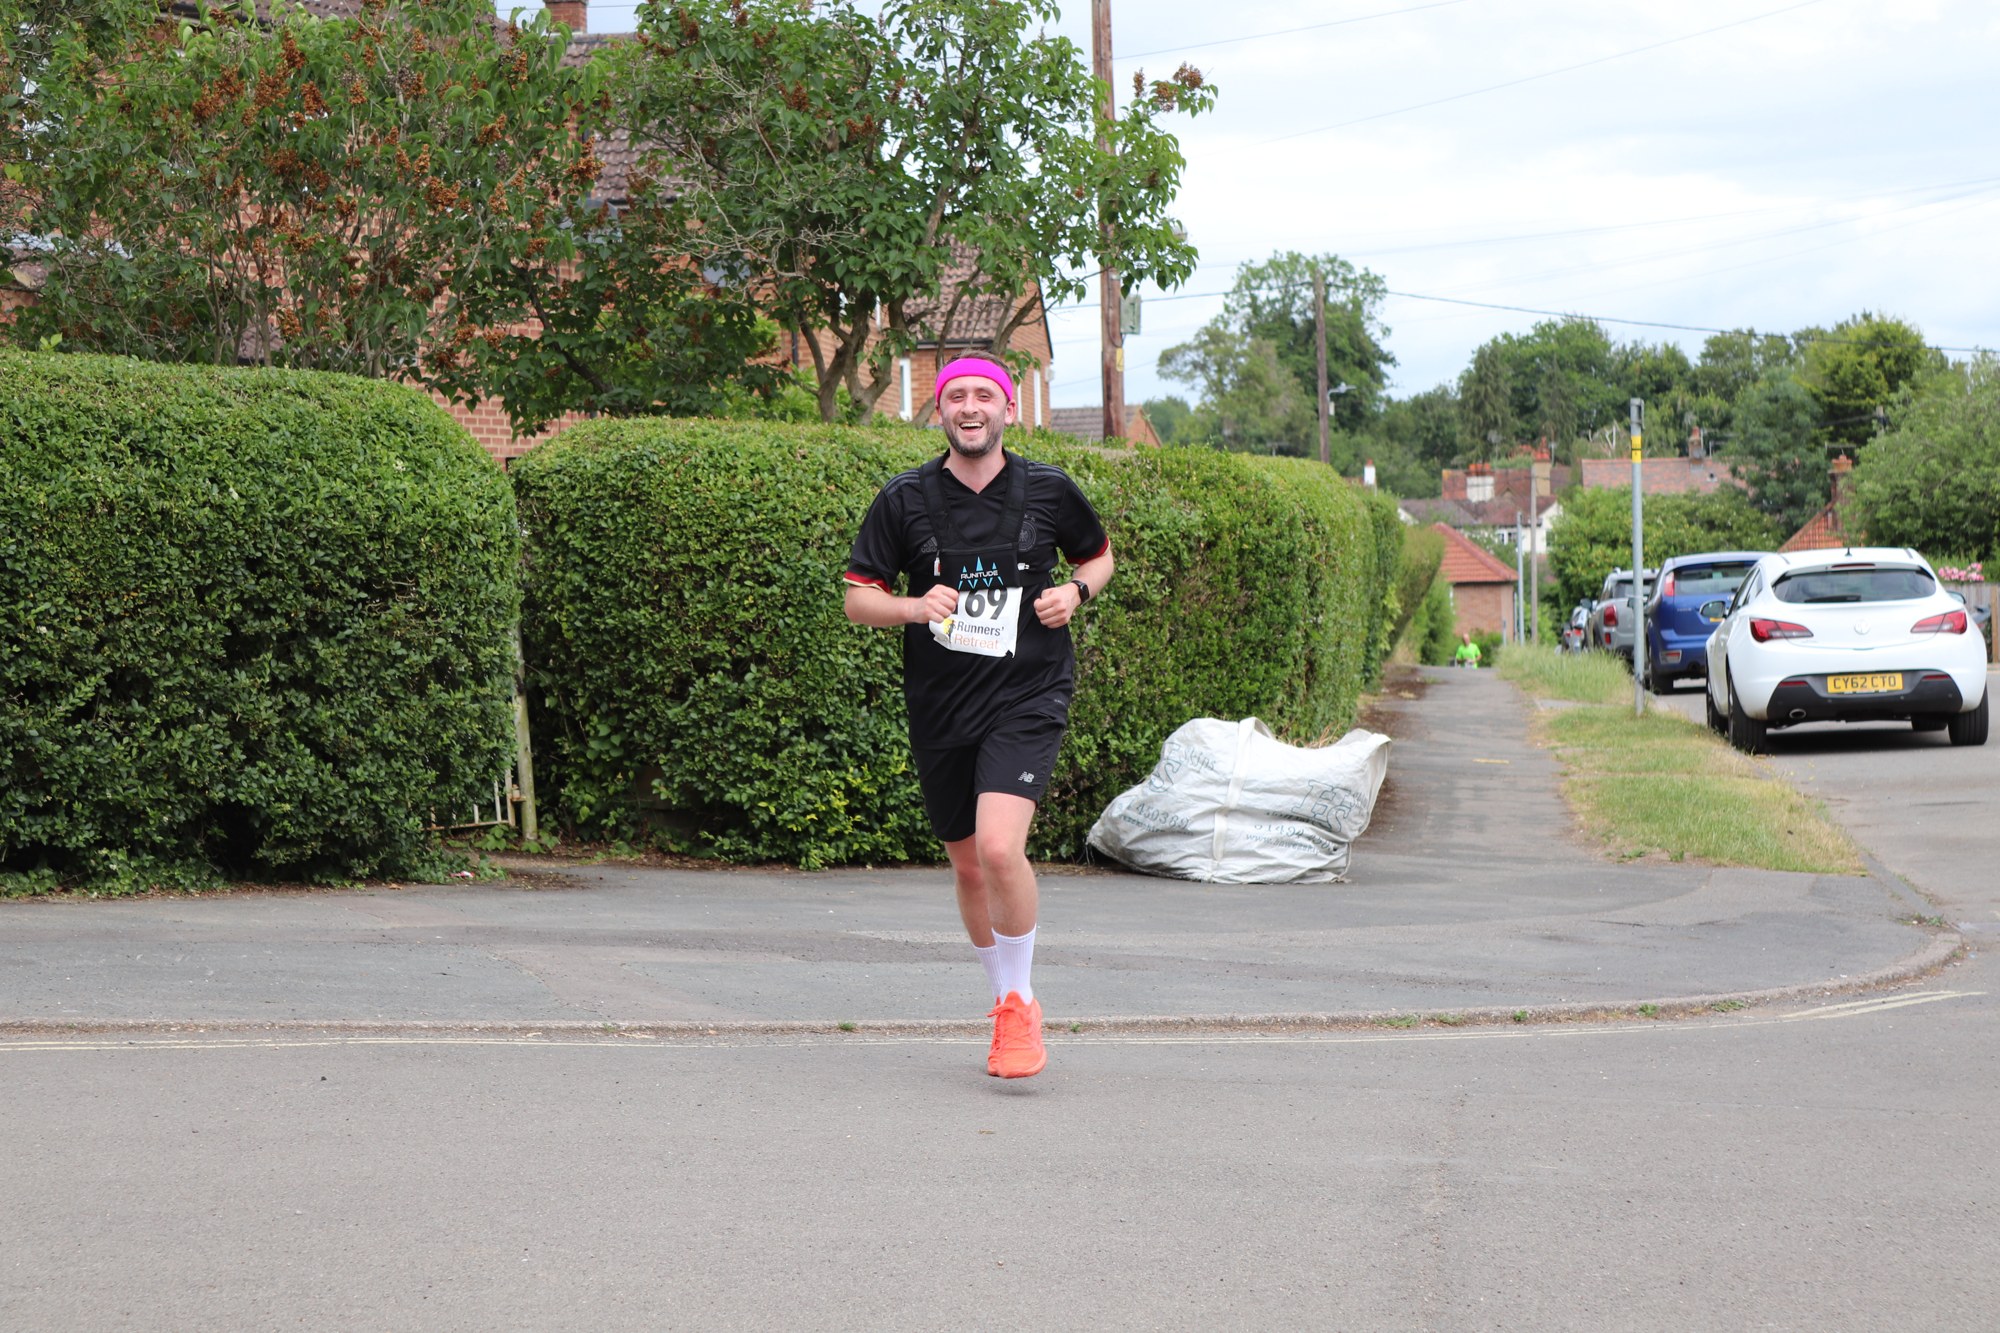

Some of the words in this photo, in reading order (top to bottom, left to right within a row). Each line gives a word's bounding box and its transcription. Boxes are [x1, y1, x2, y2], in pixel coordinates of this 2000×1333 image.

[960, 570, 998, 579] RUNITUDE
[952, 589, 1008, 620] 69
[956, 621, 1005, 636] Runners'
[954, 634, 999, 650] Retreat
[1833, 676, 1867, 690] CY62
